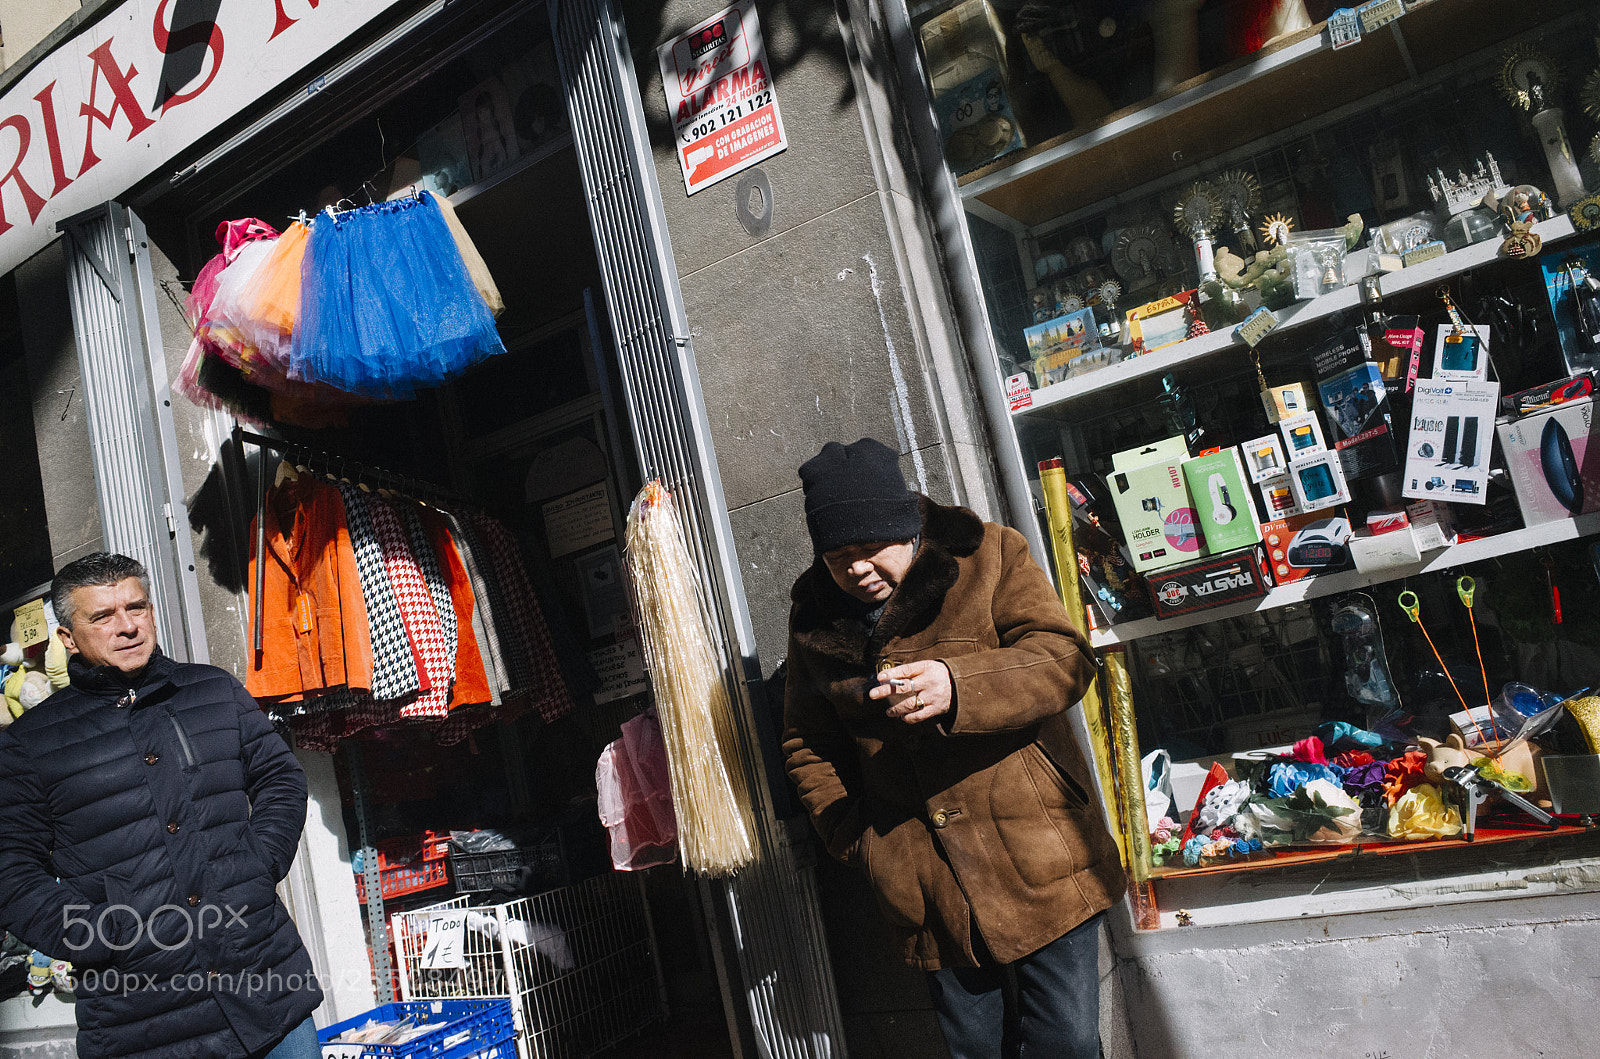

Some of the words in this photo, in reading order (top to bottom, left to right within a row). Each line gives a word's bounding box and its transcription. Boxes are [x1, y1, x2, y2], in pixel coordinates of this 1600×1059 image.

[692, 36, 726, 57] SECURITAS
[682, 34, 740, 92] Direct
[676, 60, 767, 124] ALARMA
[726, 95, 737, 108] 24
[740, 79, 768, 100] HORAS
[692, 119, 716, 140] 902
[720, 105, 742, 125] 121
[748, 90, 772, 111] 122
[715, 135, 730, 148] CON
[716, 148, 729, 160] DE
[730, 123, 775, 154] IMAGENES
[1313, 344, 1345, 361] WIRELESS
[1315, 354, 1338, 369] MOBILE
[1338, 344, 1360, 358] PHONE
[1317, 357, 1347, 375] MONOPOD
[1132, 528, 1160, 540] HOLDER
[1304, 547, 1331, 558] 12:00
[1166, 588, 1181, 598] 300
[1191, 571, 1253, 596] RASTA
